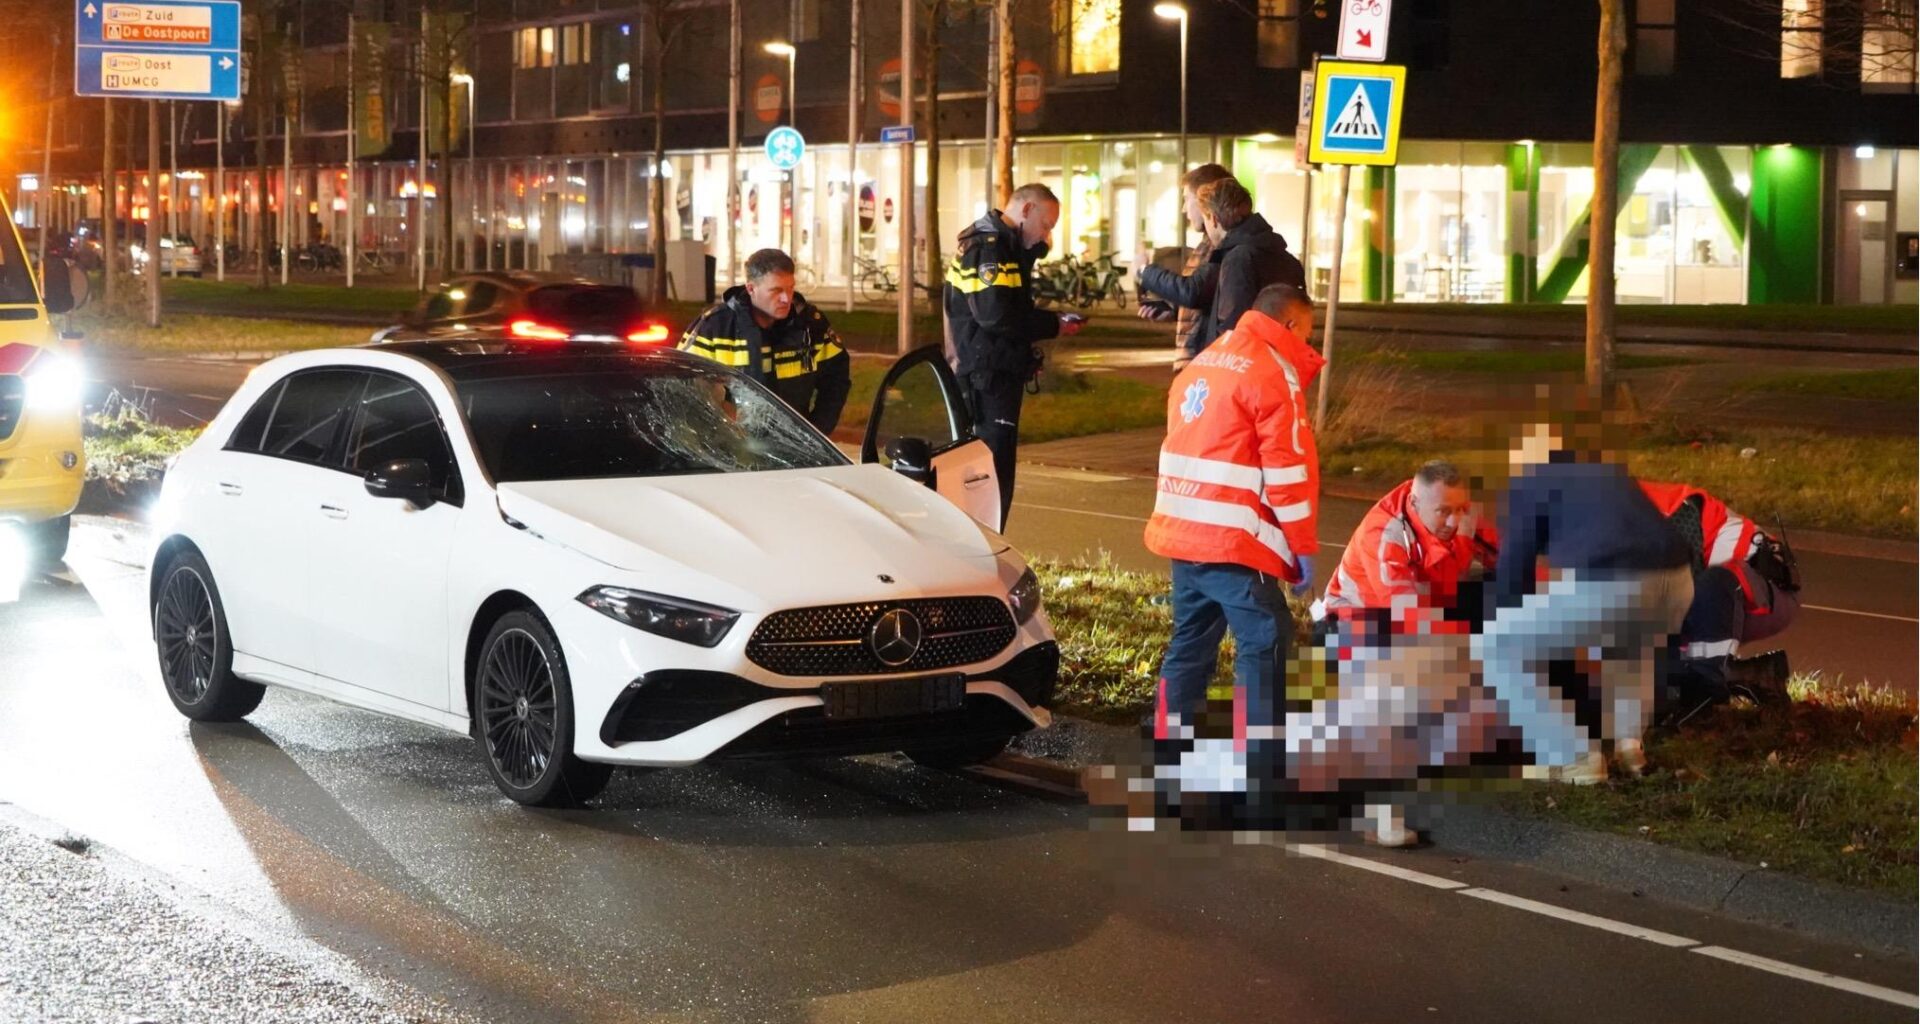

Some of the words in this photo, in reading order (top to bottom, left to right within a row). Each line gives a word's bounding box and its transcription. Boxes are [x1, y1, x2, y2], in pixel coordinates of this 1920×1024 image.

[146, 10, 174, 21] Zuid
[122, 25, 140, 38] De
[143, 26, 208, 40] Oostpoort
[145, 59, 172, 70] Oost
[122, 76, 159, 87] UMCG
